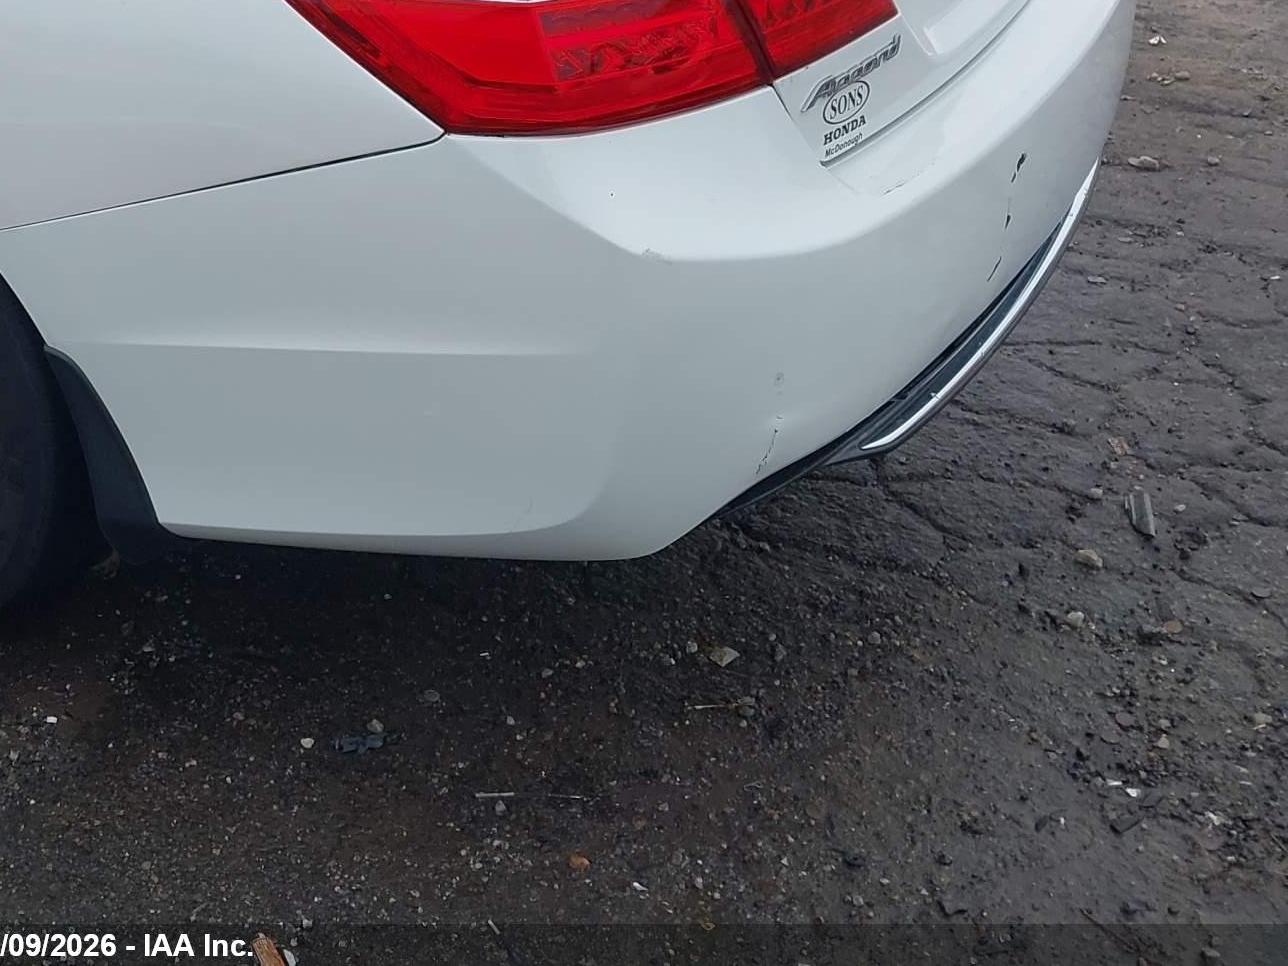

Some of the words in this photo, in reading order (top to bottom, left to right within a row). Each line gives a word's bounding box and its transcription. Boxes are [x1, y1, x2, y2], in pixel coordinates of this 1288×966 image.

[801, 34, 901, 113] Accord
[829, 86, 863, 120] SONS
[823, 115, 867, 145] HONDA
[824, 134, 863, 157] McDonough
